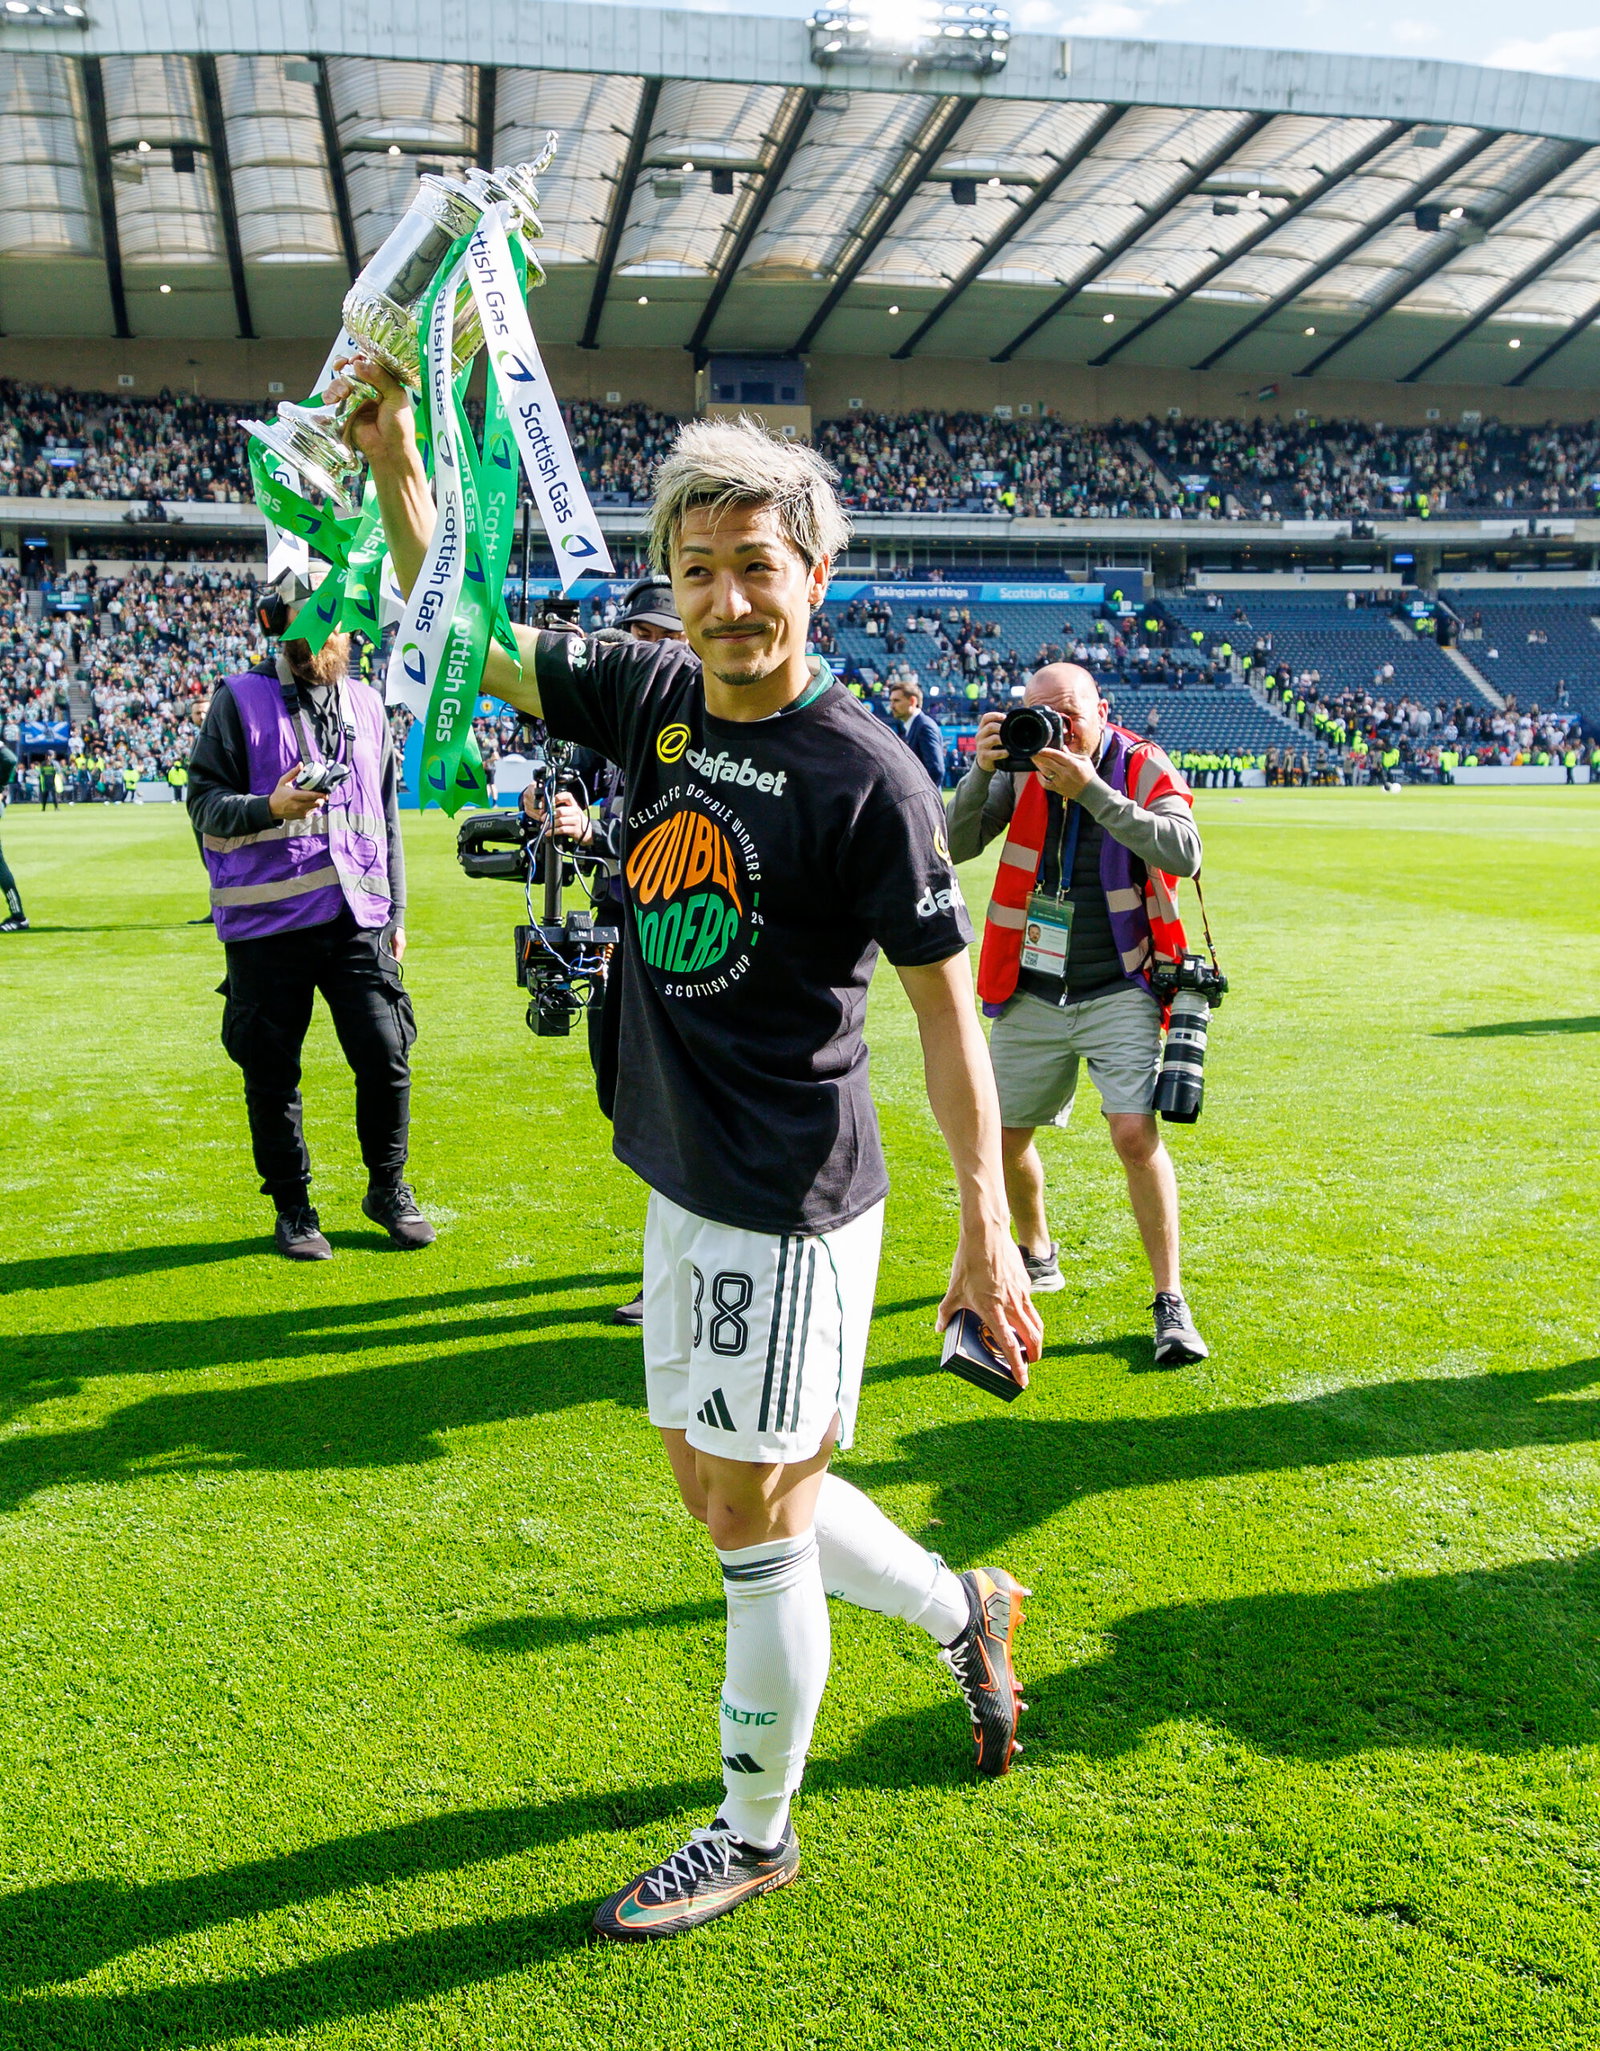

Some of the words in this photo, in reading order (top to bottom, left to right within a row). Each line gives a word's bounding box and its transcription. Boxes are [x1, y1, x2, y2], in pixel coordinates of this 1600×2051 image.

[470, 230, 497, 283] ttish
[485, 291, 509, 336] Gas
[434, 288, 447, 362] ottish
[434, 369, 446, 416] Gas
[519, 402, 560, 484] Scottish
[548, 481, 573, 524] Gas
[464, 487, 477, 534] Gas
[429, 490, 458, 585] Scottish
[415, 590, 444, 633] Gas
[873, 586, 904, 599] Taking
[905, 589, 927, 597] care
[928, 587, 938, 597] of
[939, 587, 969, 599] things
[1000, 587, 1044, 599] Scottish
[1045, 588, 1070, 600] Gas
[435, 698, 461, 742] Gas
[685, 747, 788, 797] dafabet
[628, 793, 669, 829] CELTIC
[668, 785, 681, 802] FC
[685, 783, 734, 823] DOUBLE
[731, 817, 762, 881] WINNERS
[626, 811, 742, 918] DOUBLE
[633, 893, 740, 972] INNERS
[751, 911, 765, 925] 26
[665, 975, 729, 998] SCOTTISH
[729, 954, 752, 980] CUP
